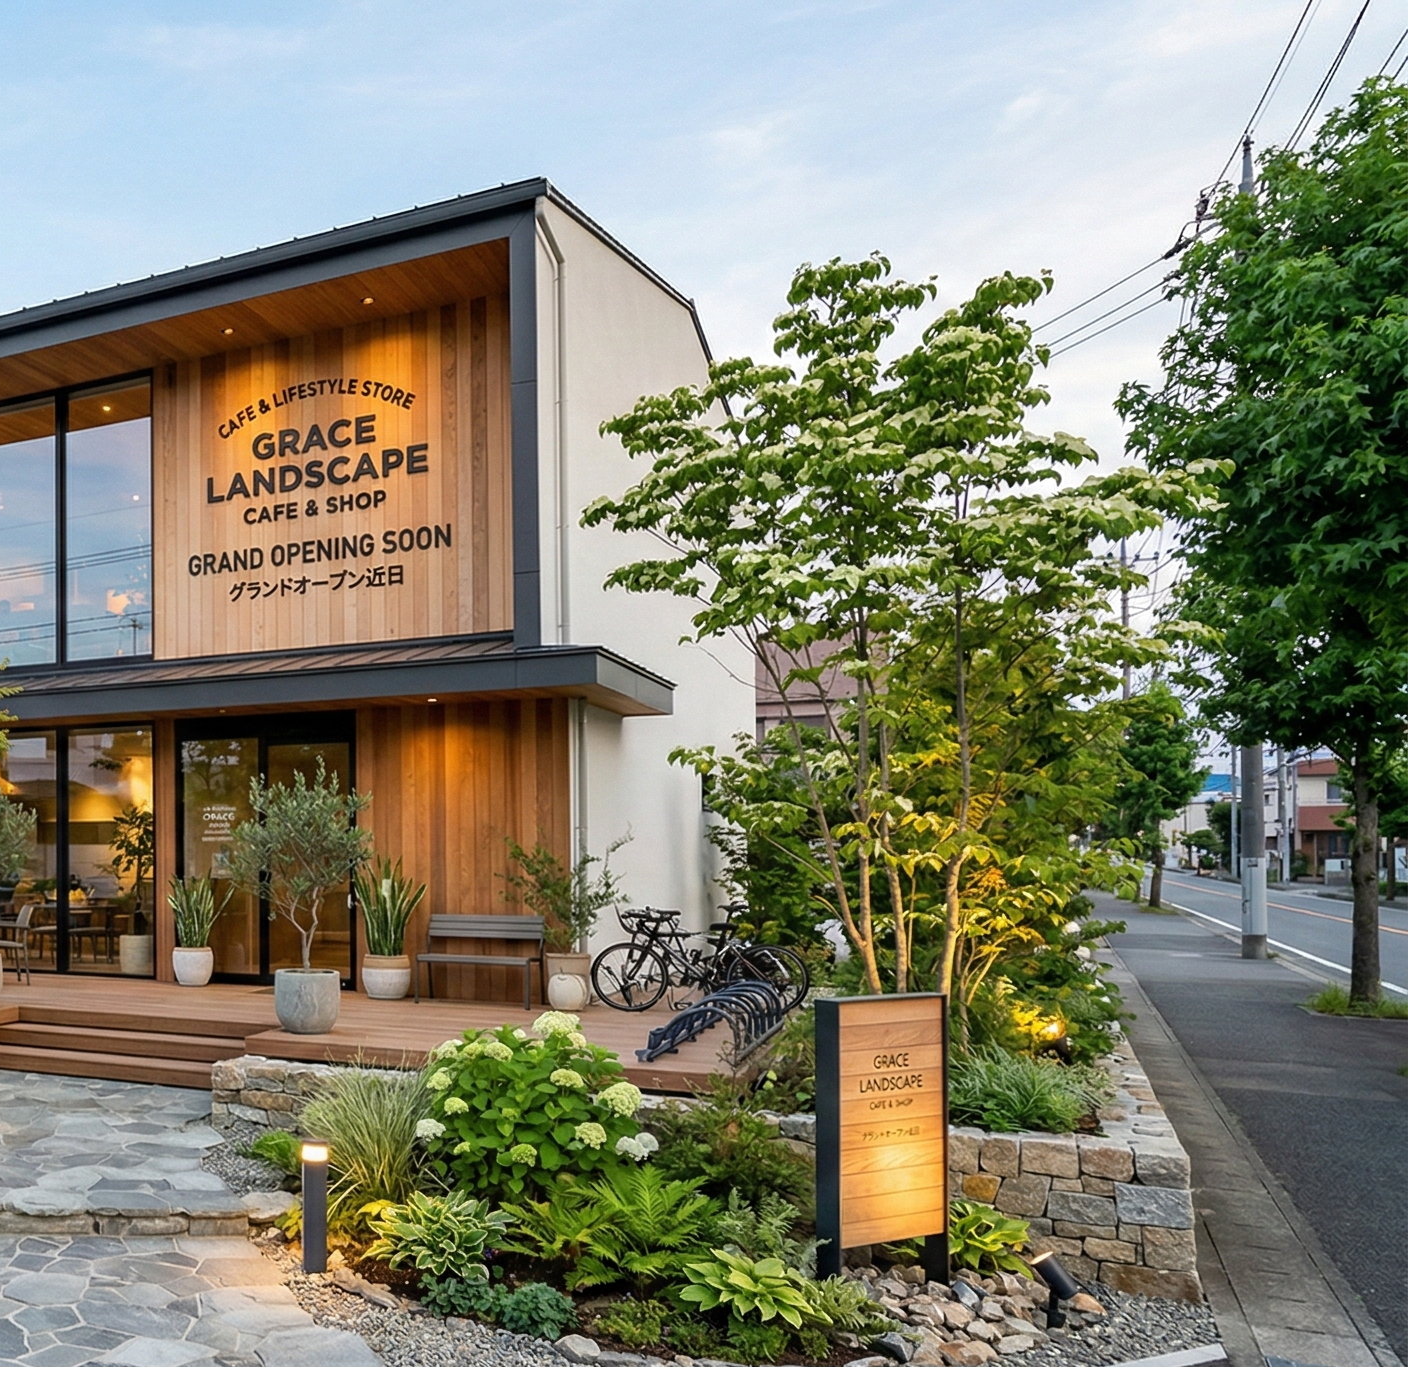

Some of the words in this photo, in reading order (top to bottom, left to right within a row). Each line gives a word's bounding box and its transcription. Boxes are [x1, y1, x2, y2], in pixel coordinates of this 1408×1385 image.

[218, 405, 257, 440] CAFE
[258, 398, 271, 414] &
[272, 378, 358, 408] LIFESTYLE
[361, 380, 416, 410] STORE
[252, 414, 376, 460] GRACE
[207, 443, 429, 504] LANDSCAPE
[243, 502, 298, 525] CAFE
[305, 499, 319, 517] &
[326, 490, 386, 514] SHOP
[188, 547, 263, 577] GRAND
[271, 533, 375, 567] OPENING
[382, 523, 452, 555] SOON
[859, 1074, 923, 1093] LANDSCAPE
[874, 1053, 909, 1069] GRACE
